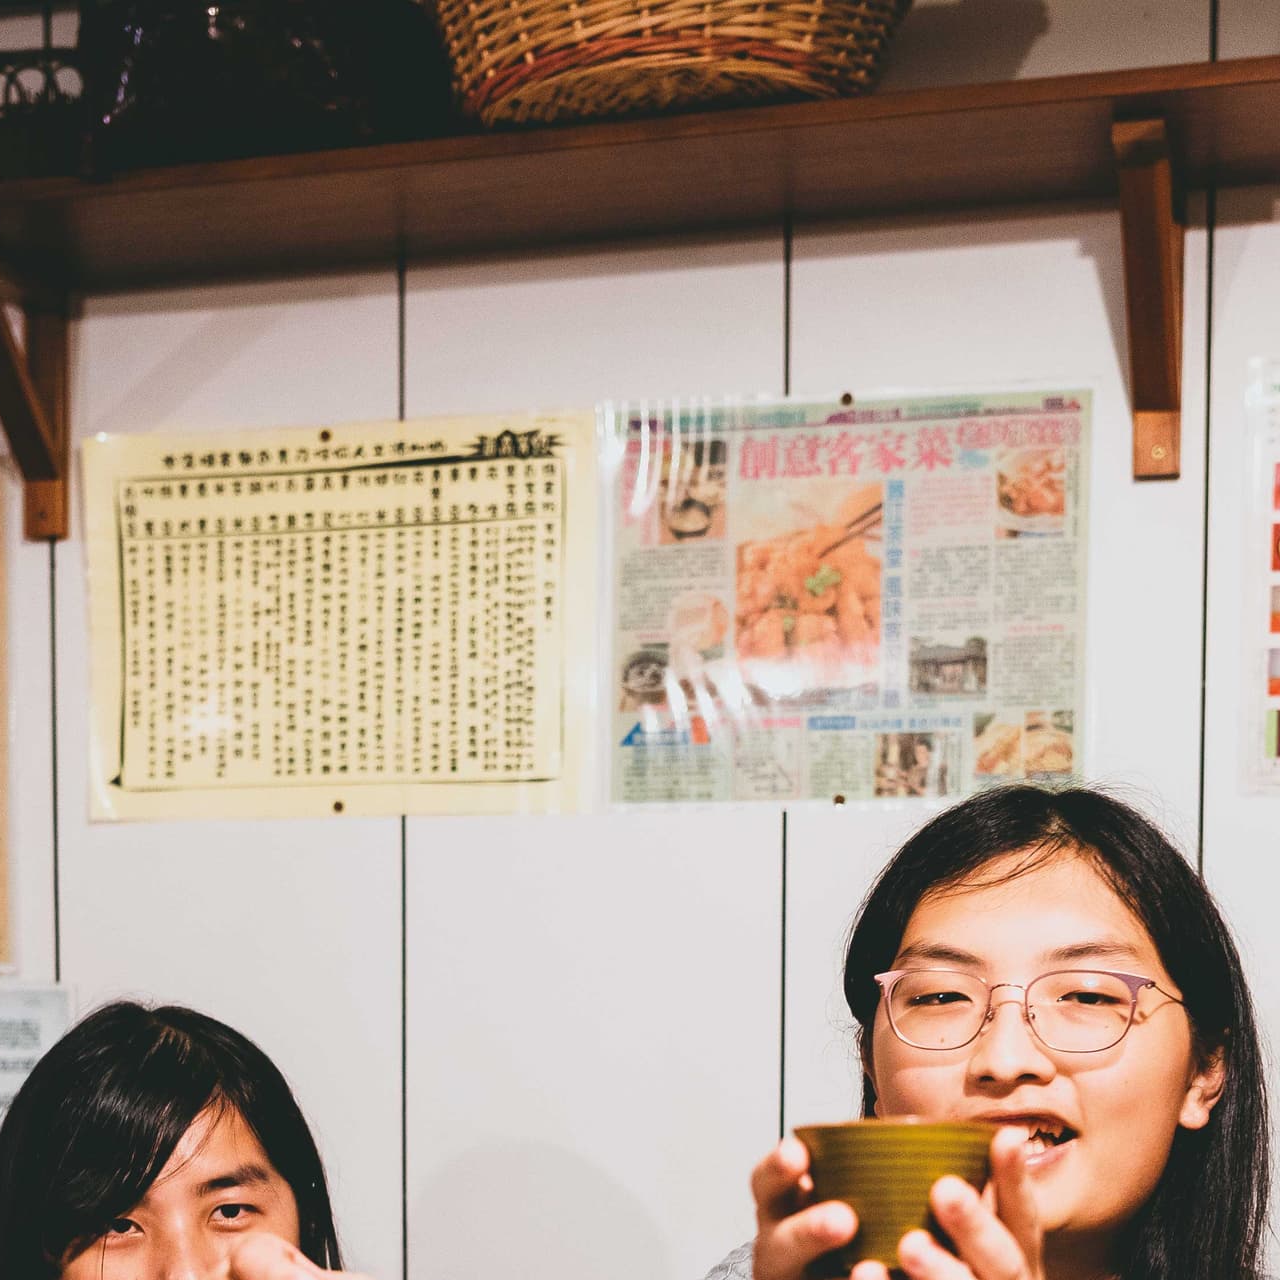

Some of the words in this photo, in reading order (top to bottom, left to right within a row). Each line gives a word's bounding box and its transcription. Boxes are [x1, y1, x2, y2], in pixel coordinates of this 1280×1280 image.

[739, 428, 953, 480] 創意客家菜
